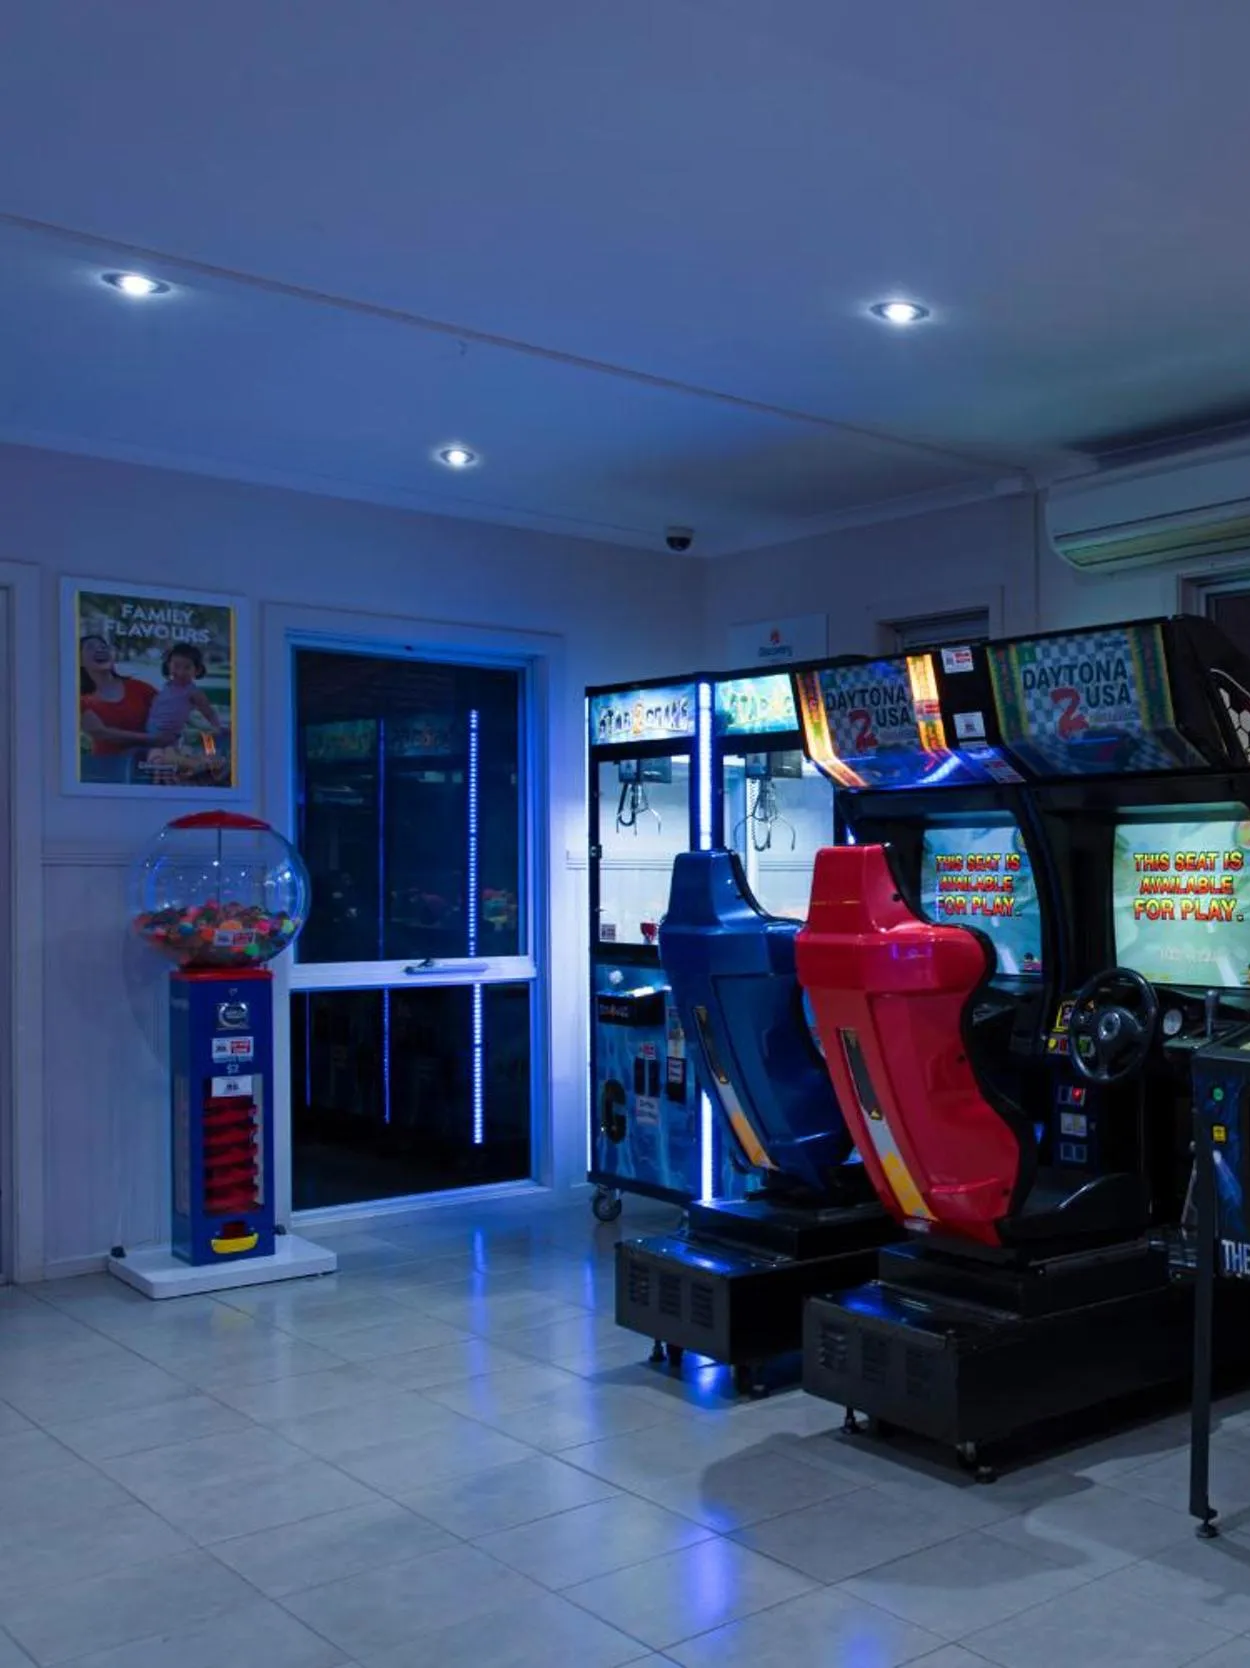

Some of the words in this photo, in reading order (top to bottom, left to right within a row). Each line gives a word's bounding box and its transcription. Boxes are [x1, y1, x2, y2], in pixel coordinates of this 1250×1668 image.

[120, 603, 194, 625] FAMILY
[104, 619, 211, 643] FLAVOURS
[1022, 658, 1129, 691] DAYTONA
[826, 684, 909, 711] DAYTONA
[1051, 687, 1090, 740] 2
[1086, 683, 1133, 709] USA
[848, 708, 878, 752] 2
[875, 705, 912, 727] USA
[936, 855, 964, 872] THIS
[967, 853, 1001, 872] SEAT
[1005, 853, 1021, 871] IS
[1133, 852, 1170, 872] THIS
[1174, 851, 1219, 872] SEAT
[1223, 850, 1245, 870] IS
[939, 876, 1014, 893] AVAILABLE
[1139, 874, 1235, 895] AVAILABLE
[936, 896, 968, 916] FOR
[1133, 898, 1175, 921] FOR
